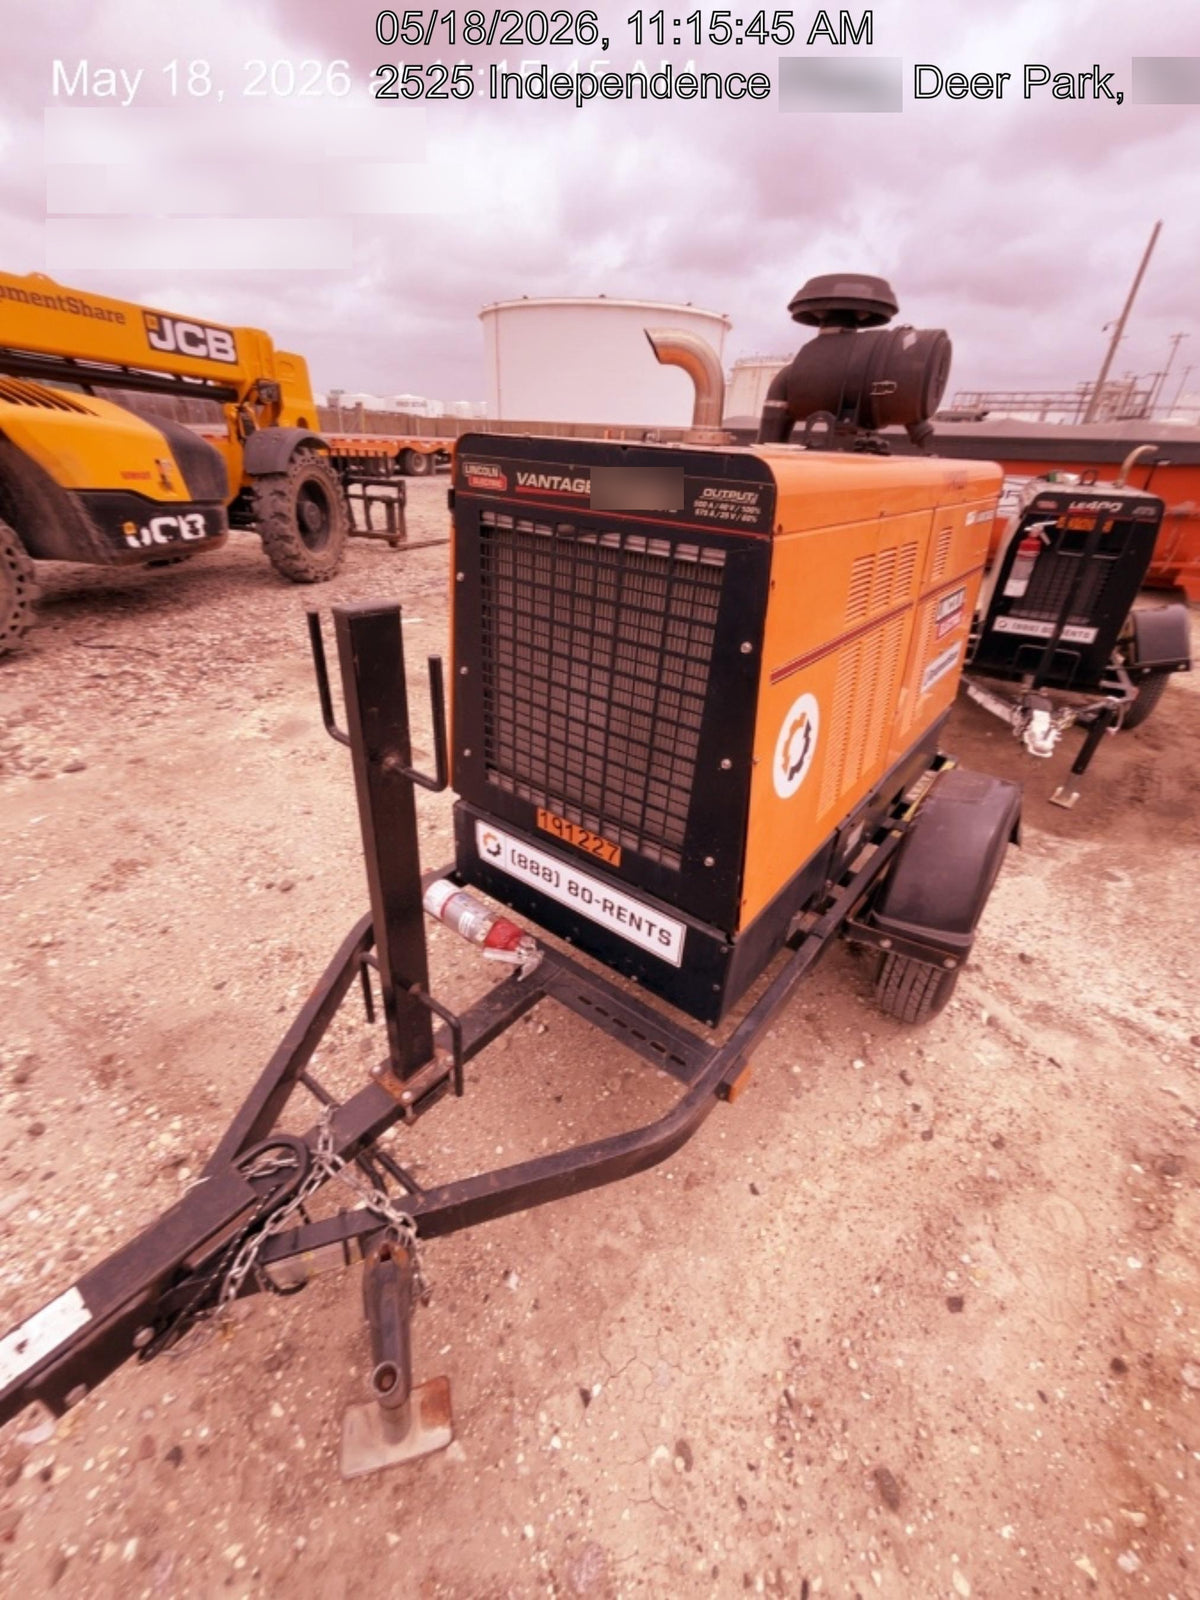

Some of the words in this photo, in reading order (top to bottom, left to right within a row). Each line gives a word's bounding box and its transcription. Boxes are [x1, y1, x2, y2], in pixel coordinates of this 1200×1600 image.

[147, 317, 237, 364] JCB
[702, 488, 755, 502] OUTPUT
[539, 811, 621, 860] 191227
[511, 848, 560, 888] (888)
[568, 879, 672, 947] 80-RENTS
